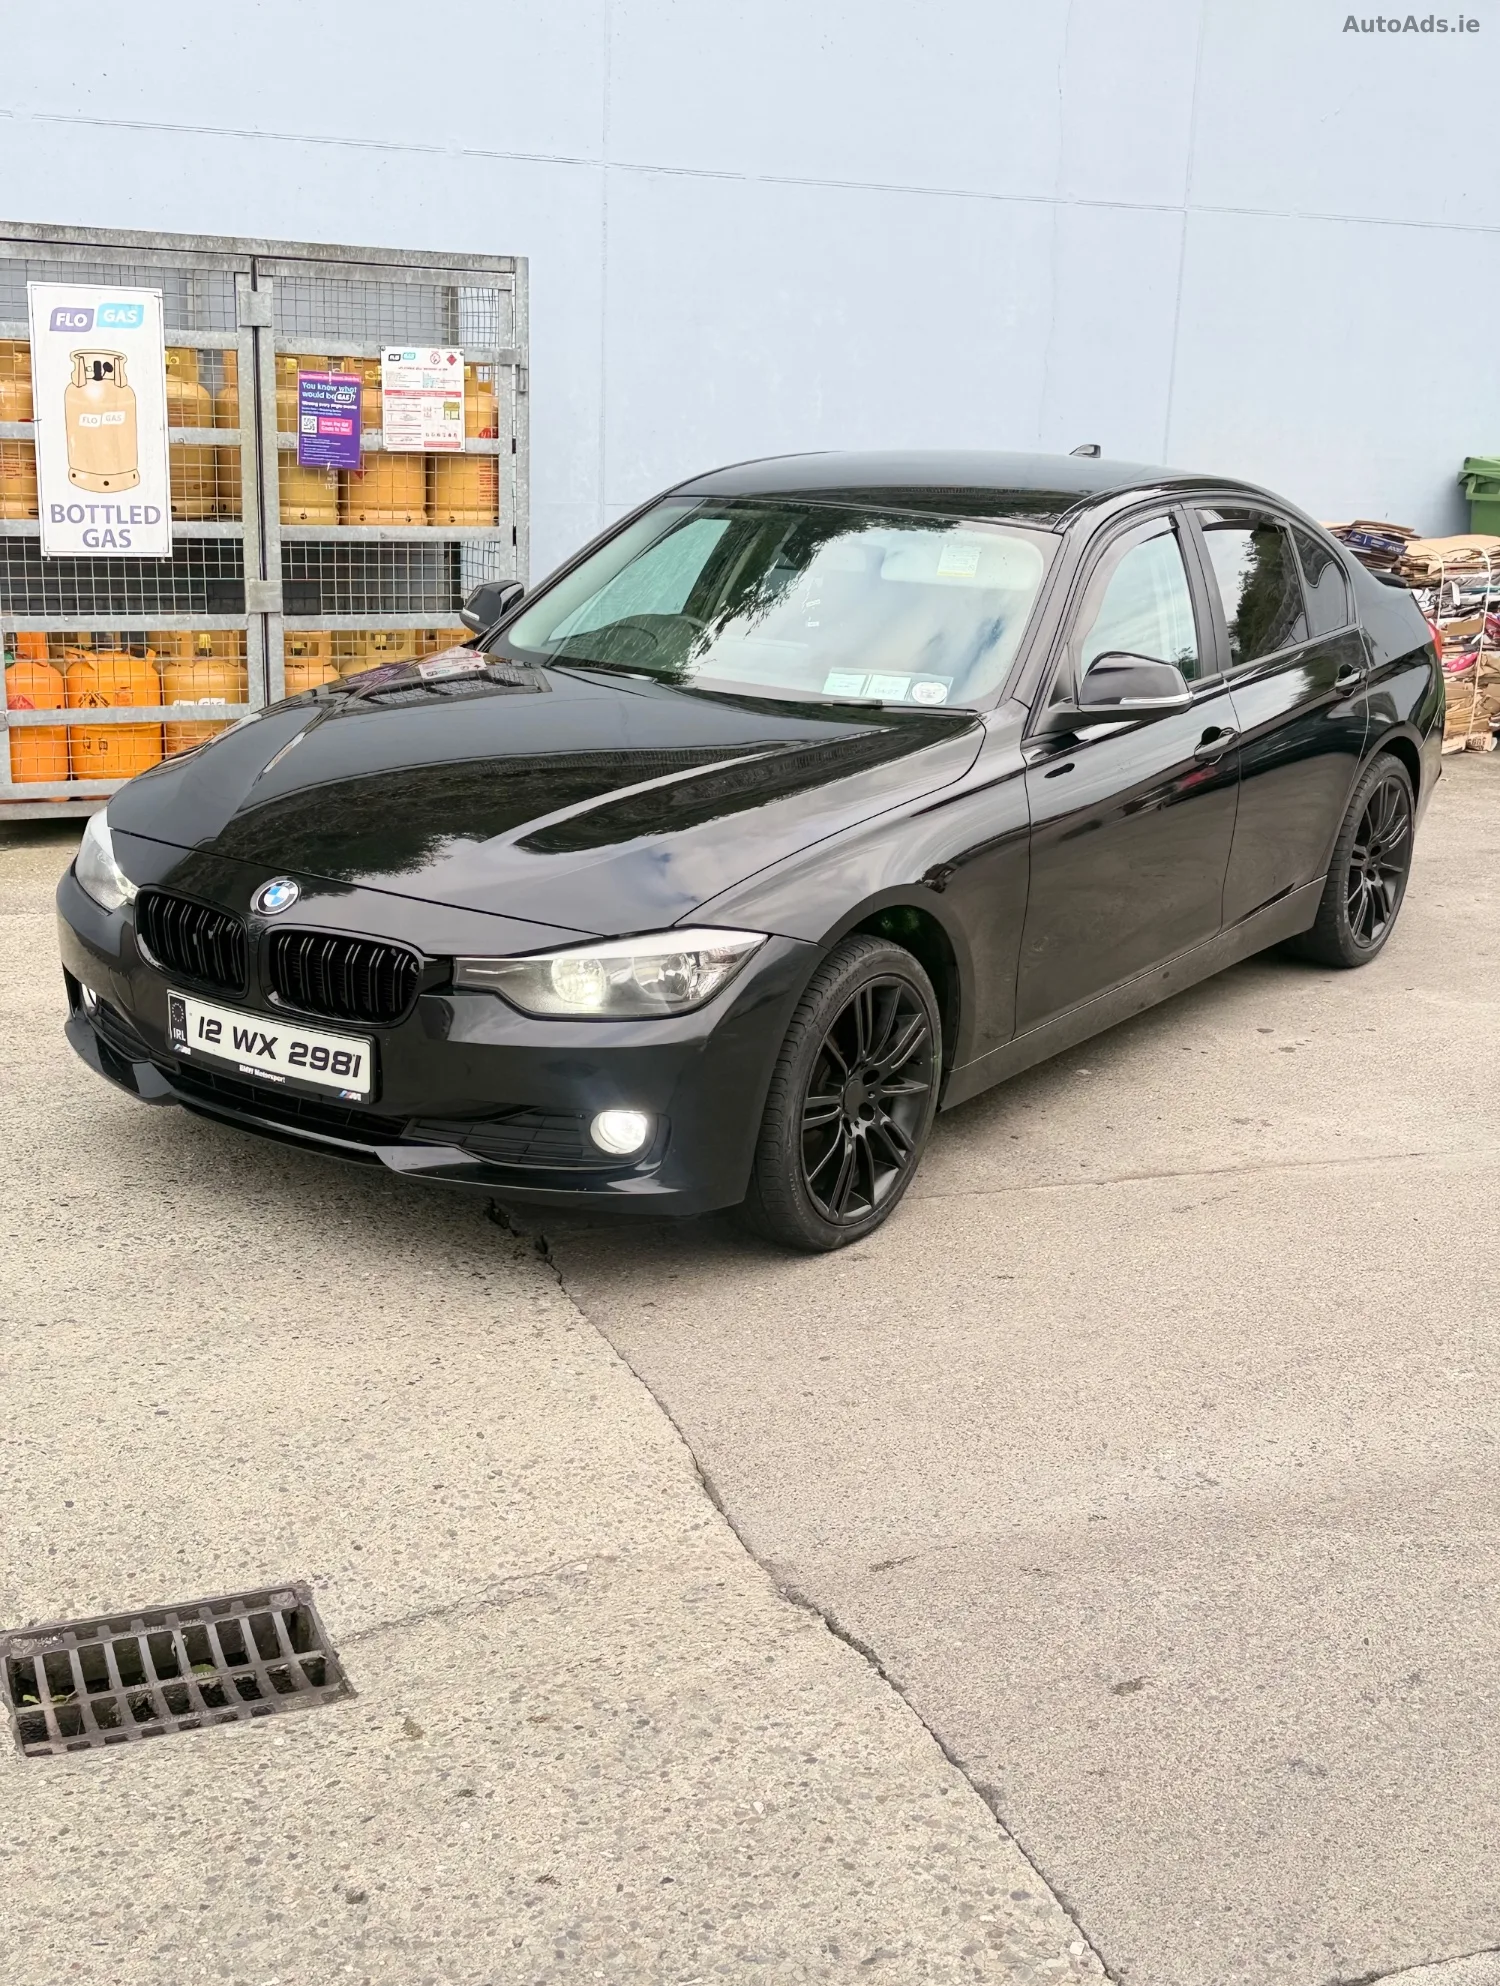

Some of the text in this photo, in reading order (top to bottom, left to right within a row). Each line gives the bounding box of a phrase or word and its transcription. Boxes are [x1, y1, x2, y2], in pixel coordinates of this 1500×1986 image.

[56, 309, 138, 327] FLO GAS
[302, 381, 316, 390] You
[317, 383, 338, 392] know
[302, 391, 325, 399] would
[81, 414, 123, 425] FLO GAS
[50, 503, 162, 526] BOTTLED
[82, 527, 133, 549] GAS
[172, 1027, 187, 1042] IRL
[198, 1015, 363, 1078] 12 WX 2981
[239, 1063, 287, 1084] BMW Motorsport
